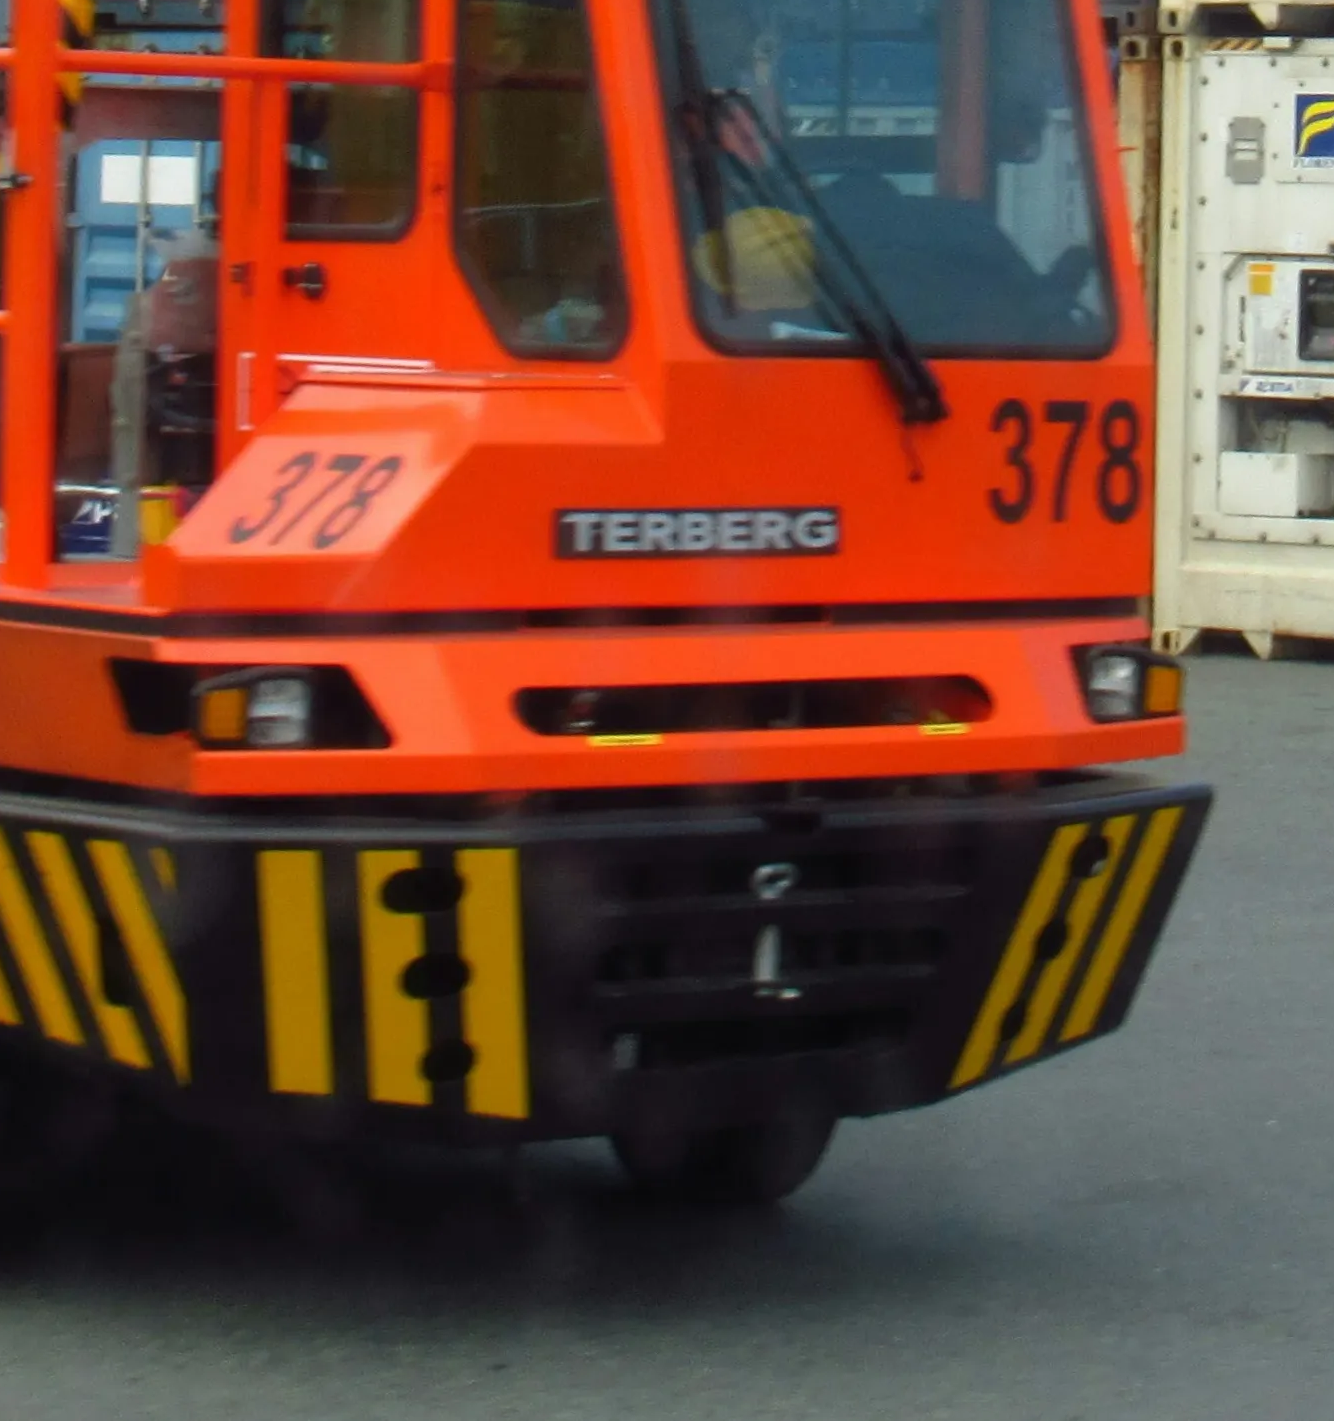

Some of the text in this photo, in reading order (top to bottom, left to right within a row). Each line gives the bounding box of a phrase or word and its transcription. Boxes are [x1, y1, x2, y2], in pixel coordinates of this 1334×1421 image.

[229, 451, 403, 550] 378
[989, 398, 1143, 524] 378
[561, 511, 838, 554] TERBERG
